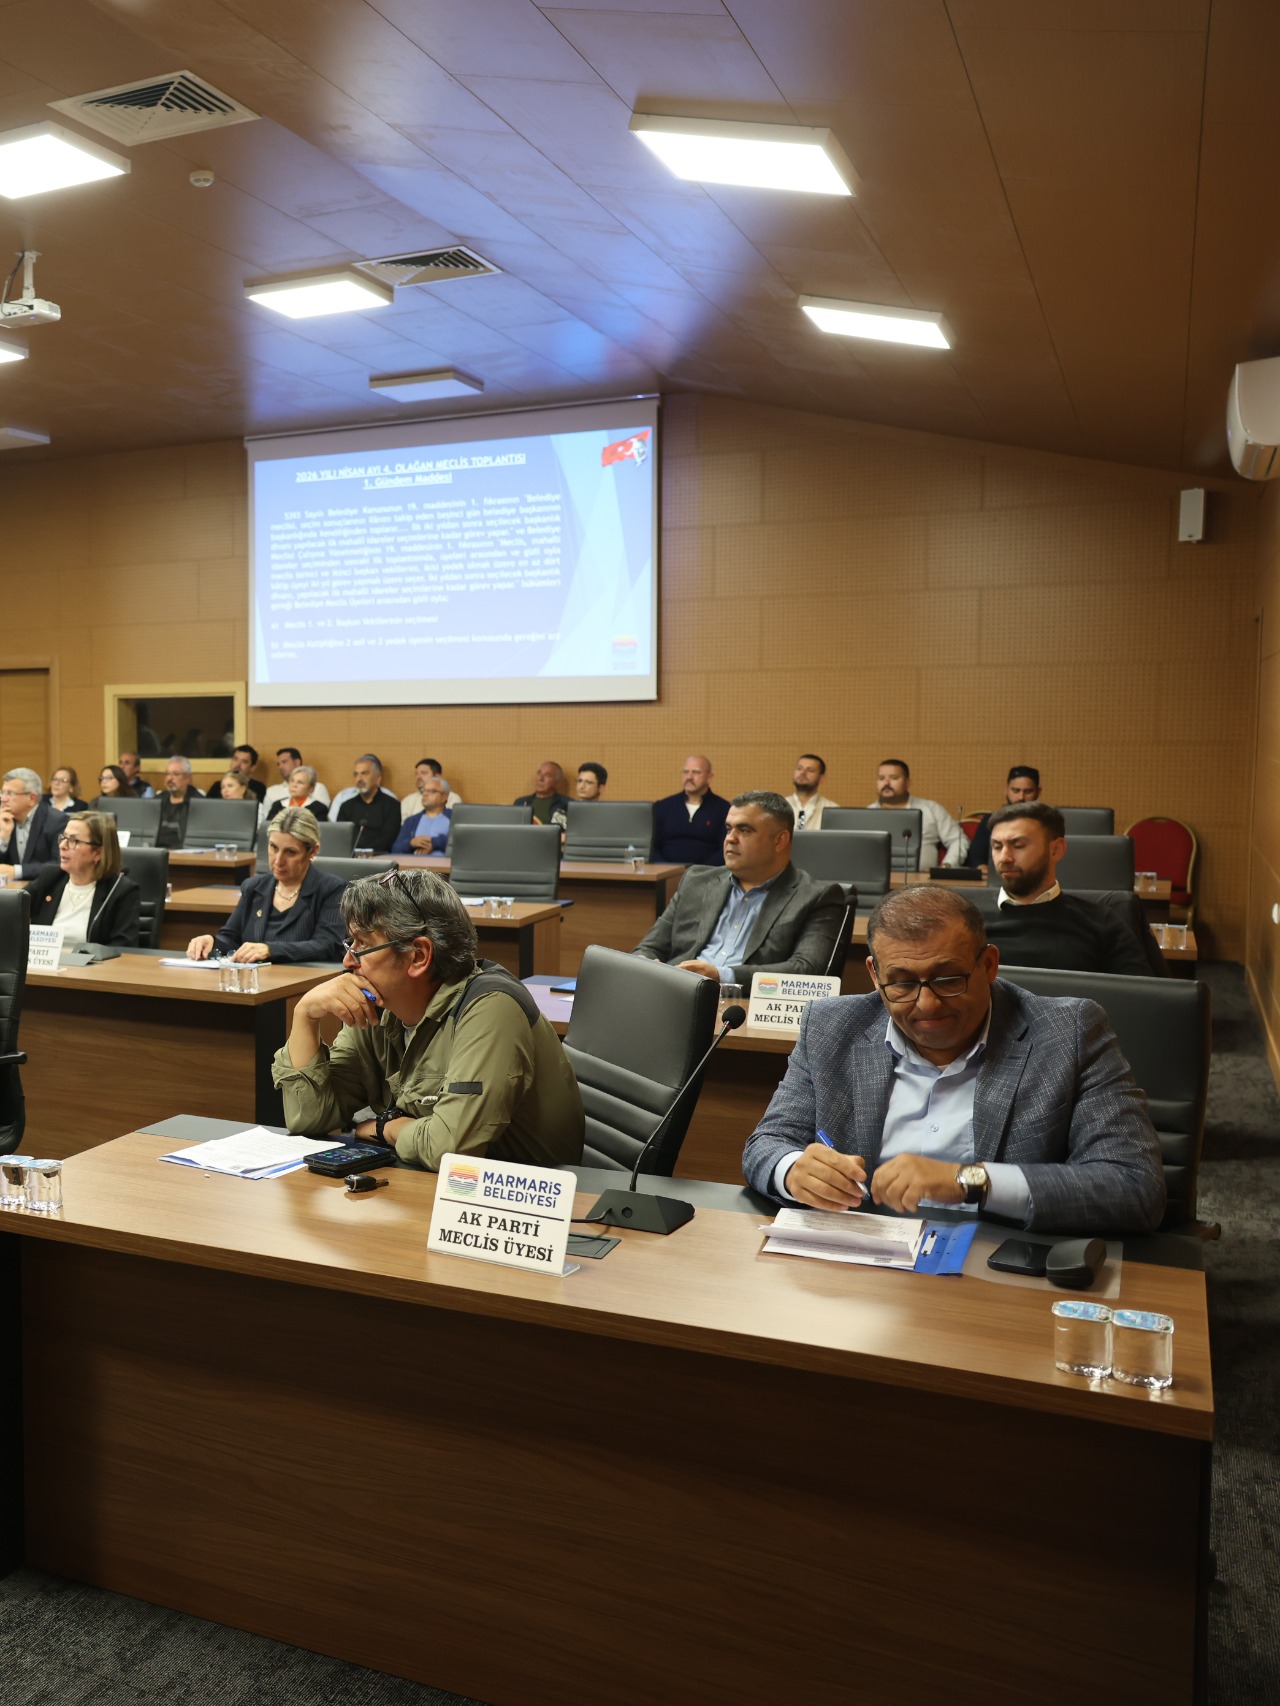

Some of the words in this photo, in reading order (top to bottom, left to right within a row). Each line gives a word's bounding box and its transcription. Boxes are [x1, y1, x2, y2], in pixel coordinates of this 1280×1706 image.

[339, 466, 365, 478] NİSAN
[395, 460, 433, 474] OLAĞAN
[436, 457, 468, 471] MECLİS
[471, 452, 527, 468] TOPLANTISI
[754, 1014, 794, 1025] MECLİS
[766, 1003, 781, 1011] AK
[458, 1211, 482, 1227] AK
[488, 1215, 540, 1237] PARTİ
[438, 1228, 499, 1252] MECLİS
[504, 1236, 554, 1262] ÜYESİ
